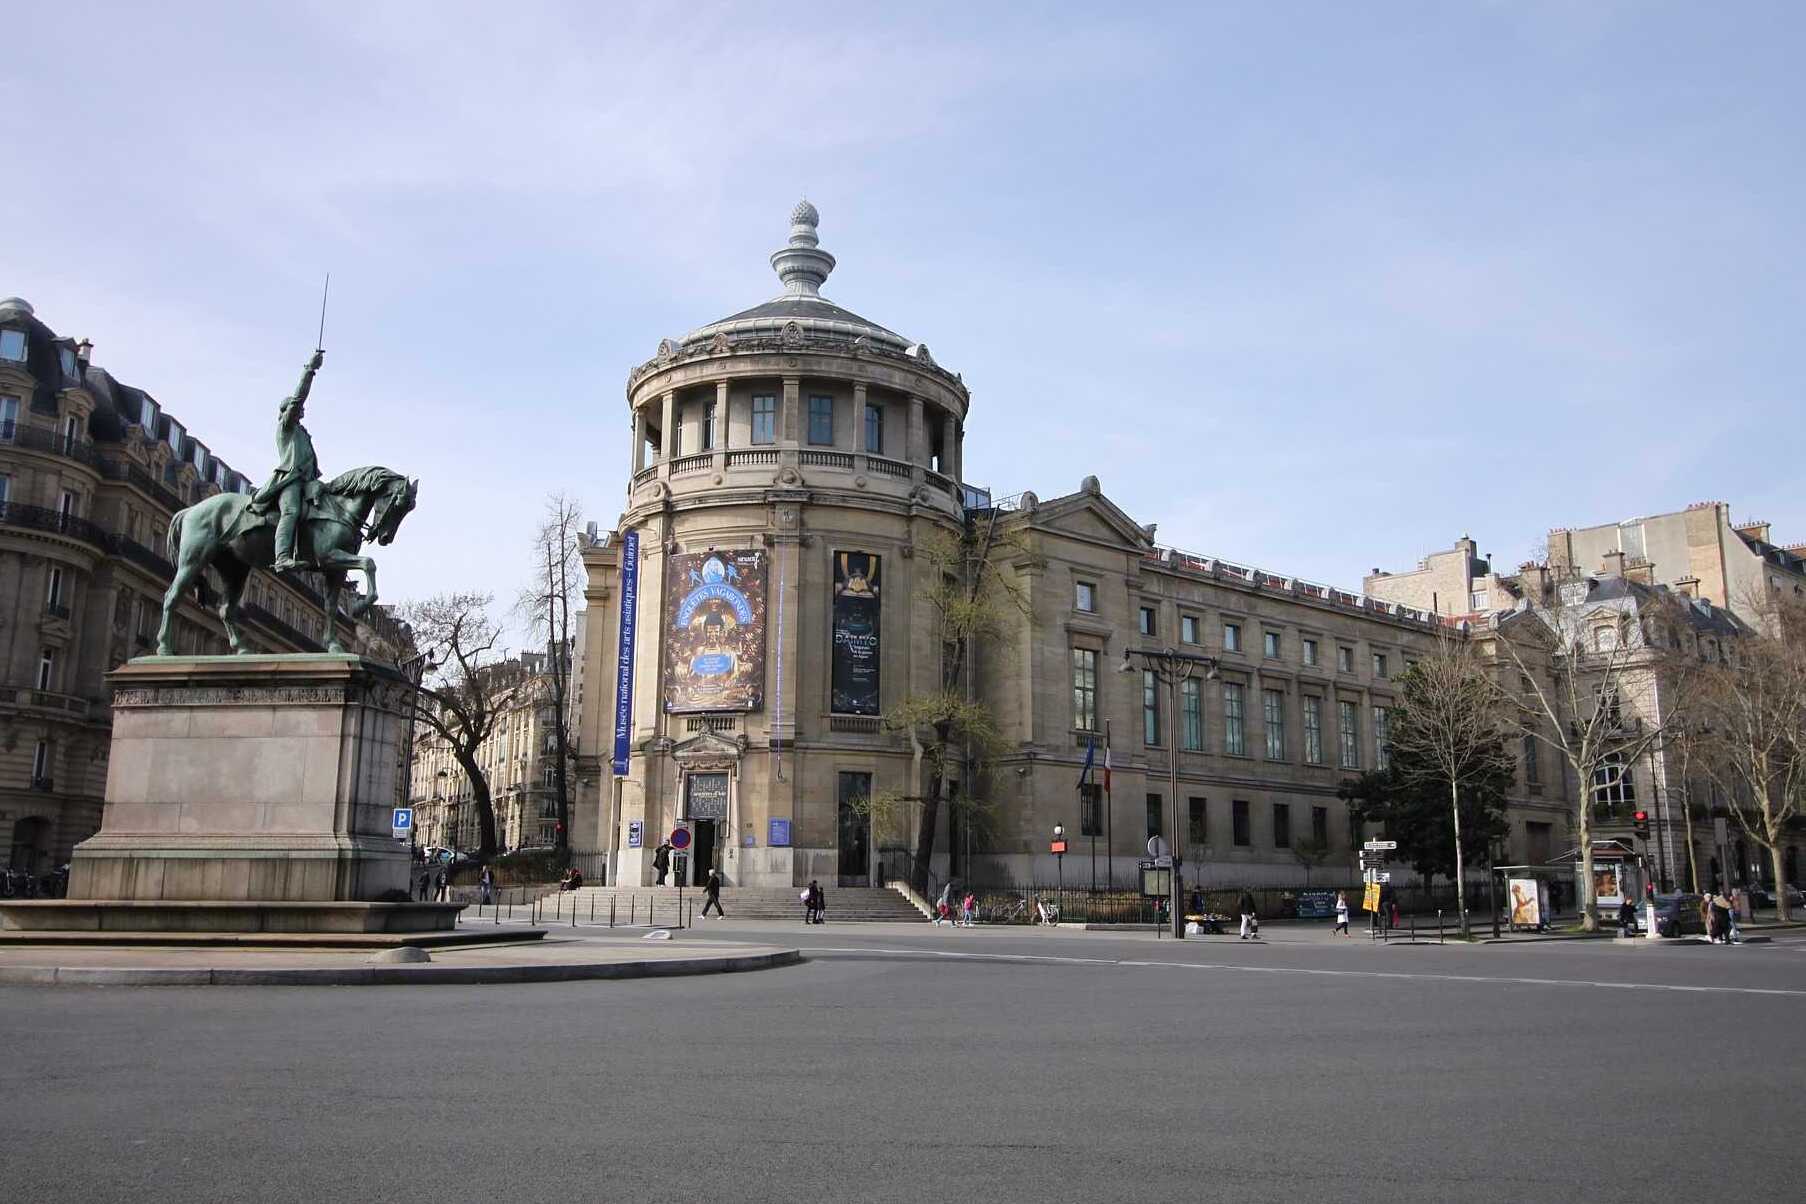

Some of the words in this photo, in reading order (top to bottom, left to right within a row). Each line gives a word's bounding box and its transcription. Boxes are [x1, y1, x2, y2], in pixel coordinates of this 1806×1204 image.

[624, 535, 636, 571] Guimet
[622, 579, 635, 625] asiatiques
[622, 626, 632, 645] arts
[619, 647, 631, 664] des
[618, 665, 630, 704] national
[616, 705, 628, 739] Musée
[398, 812, 407, 826] P
